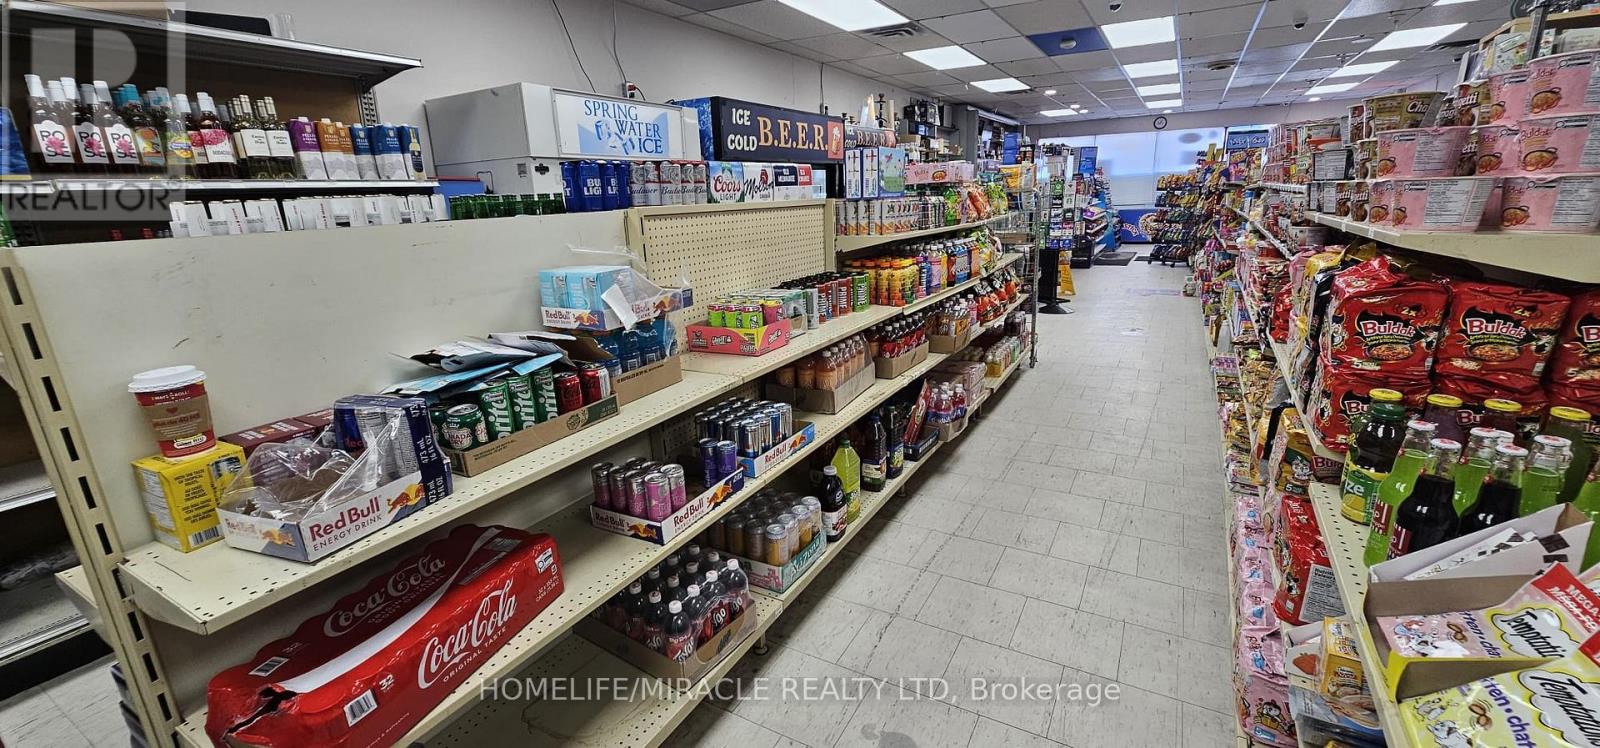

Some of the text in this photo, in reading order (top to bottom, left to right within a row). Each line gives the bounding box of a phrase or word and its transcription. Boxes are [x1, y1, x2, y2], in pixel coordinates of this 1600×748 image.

[584, 100, 638, 120] SPRING
[732, 108, 751, 125] ICE
[614, 120, 662, 138] WATER
[757, 117, 828, 150] B.E.E.R.
[639, 139, 664, 154] ICE
[727, 134, 758, 151] COLD
[584, 187, 602, 195] LIG
[586, 178, 601, 187] BU
[714, 175, 741, 193] Coors
[744, 176, 775, 199] Molson
[840, 286, 848, 308] PRIME
[1360, 320, 1416, 337] Buldak
[1466, 318, 1527, 339] Buldak
[765, 442, 787, 463] Red Bull
[309, 496, 381, 541] Red Bull
[674, 497, 704, 527] Red Bull
[313, 514, 382, 551] ENERGY DRINK
[323, 554, 446, 638] Coca-Cola
[418, 576, 518, 690] Coca-Cola
[443, 626, 507, 683] ORIGINAL TASTE
[379, 673, 394, 690] 32
